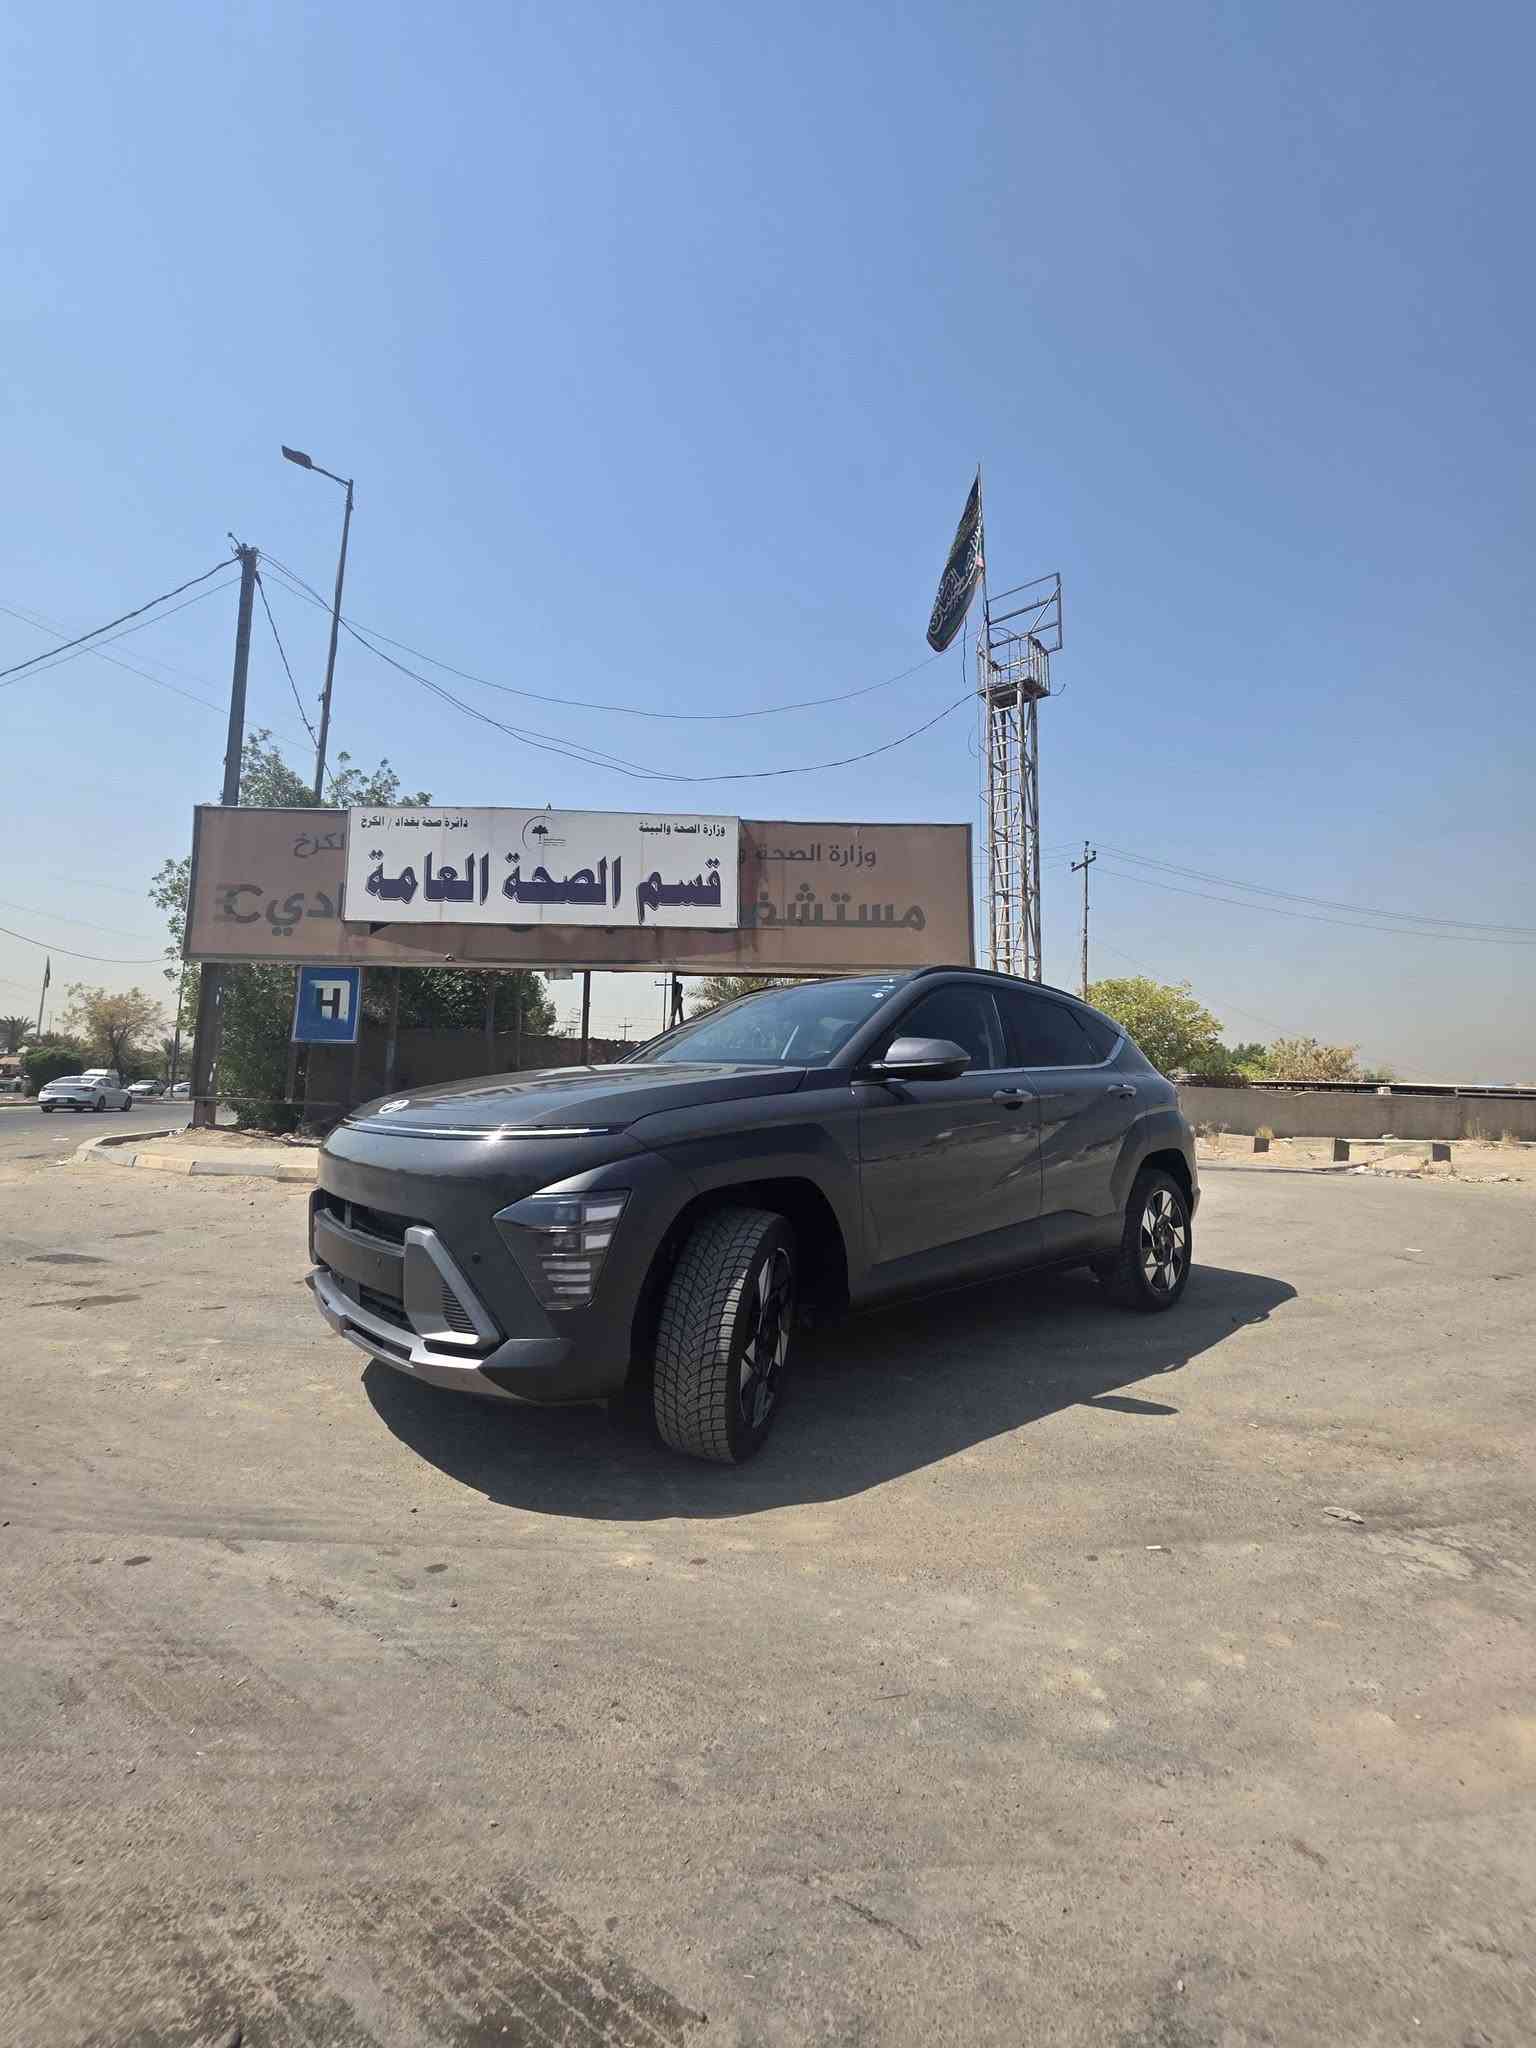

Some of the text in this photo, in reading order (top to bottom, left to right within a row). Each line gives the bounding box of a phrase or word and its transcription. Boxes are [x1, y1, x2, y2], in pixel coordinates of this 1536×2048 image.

[360, 815, 385, 829] الكرخ
[395, 816, 420, 831] بغداد
[422, 817, 442, 828] صحة
[445, 816, 469, 831] دائرة
[638, 822, 726, 837] وزارة الصحة والبيئة
[294, 832, 345, 858] لكرخ
[756, 842, 822, 862] الصحة
[828, 845, 877, 868] وزارة
[365, 849, 722, 925] قسم الصحة العامة
[757, 883, 926, 930] مستشف
